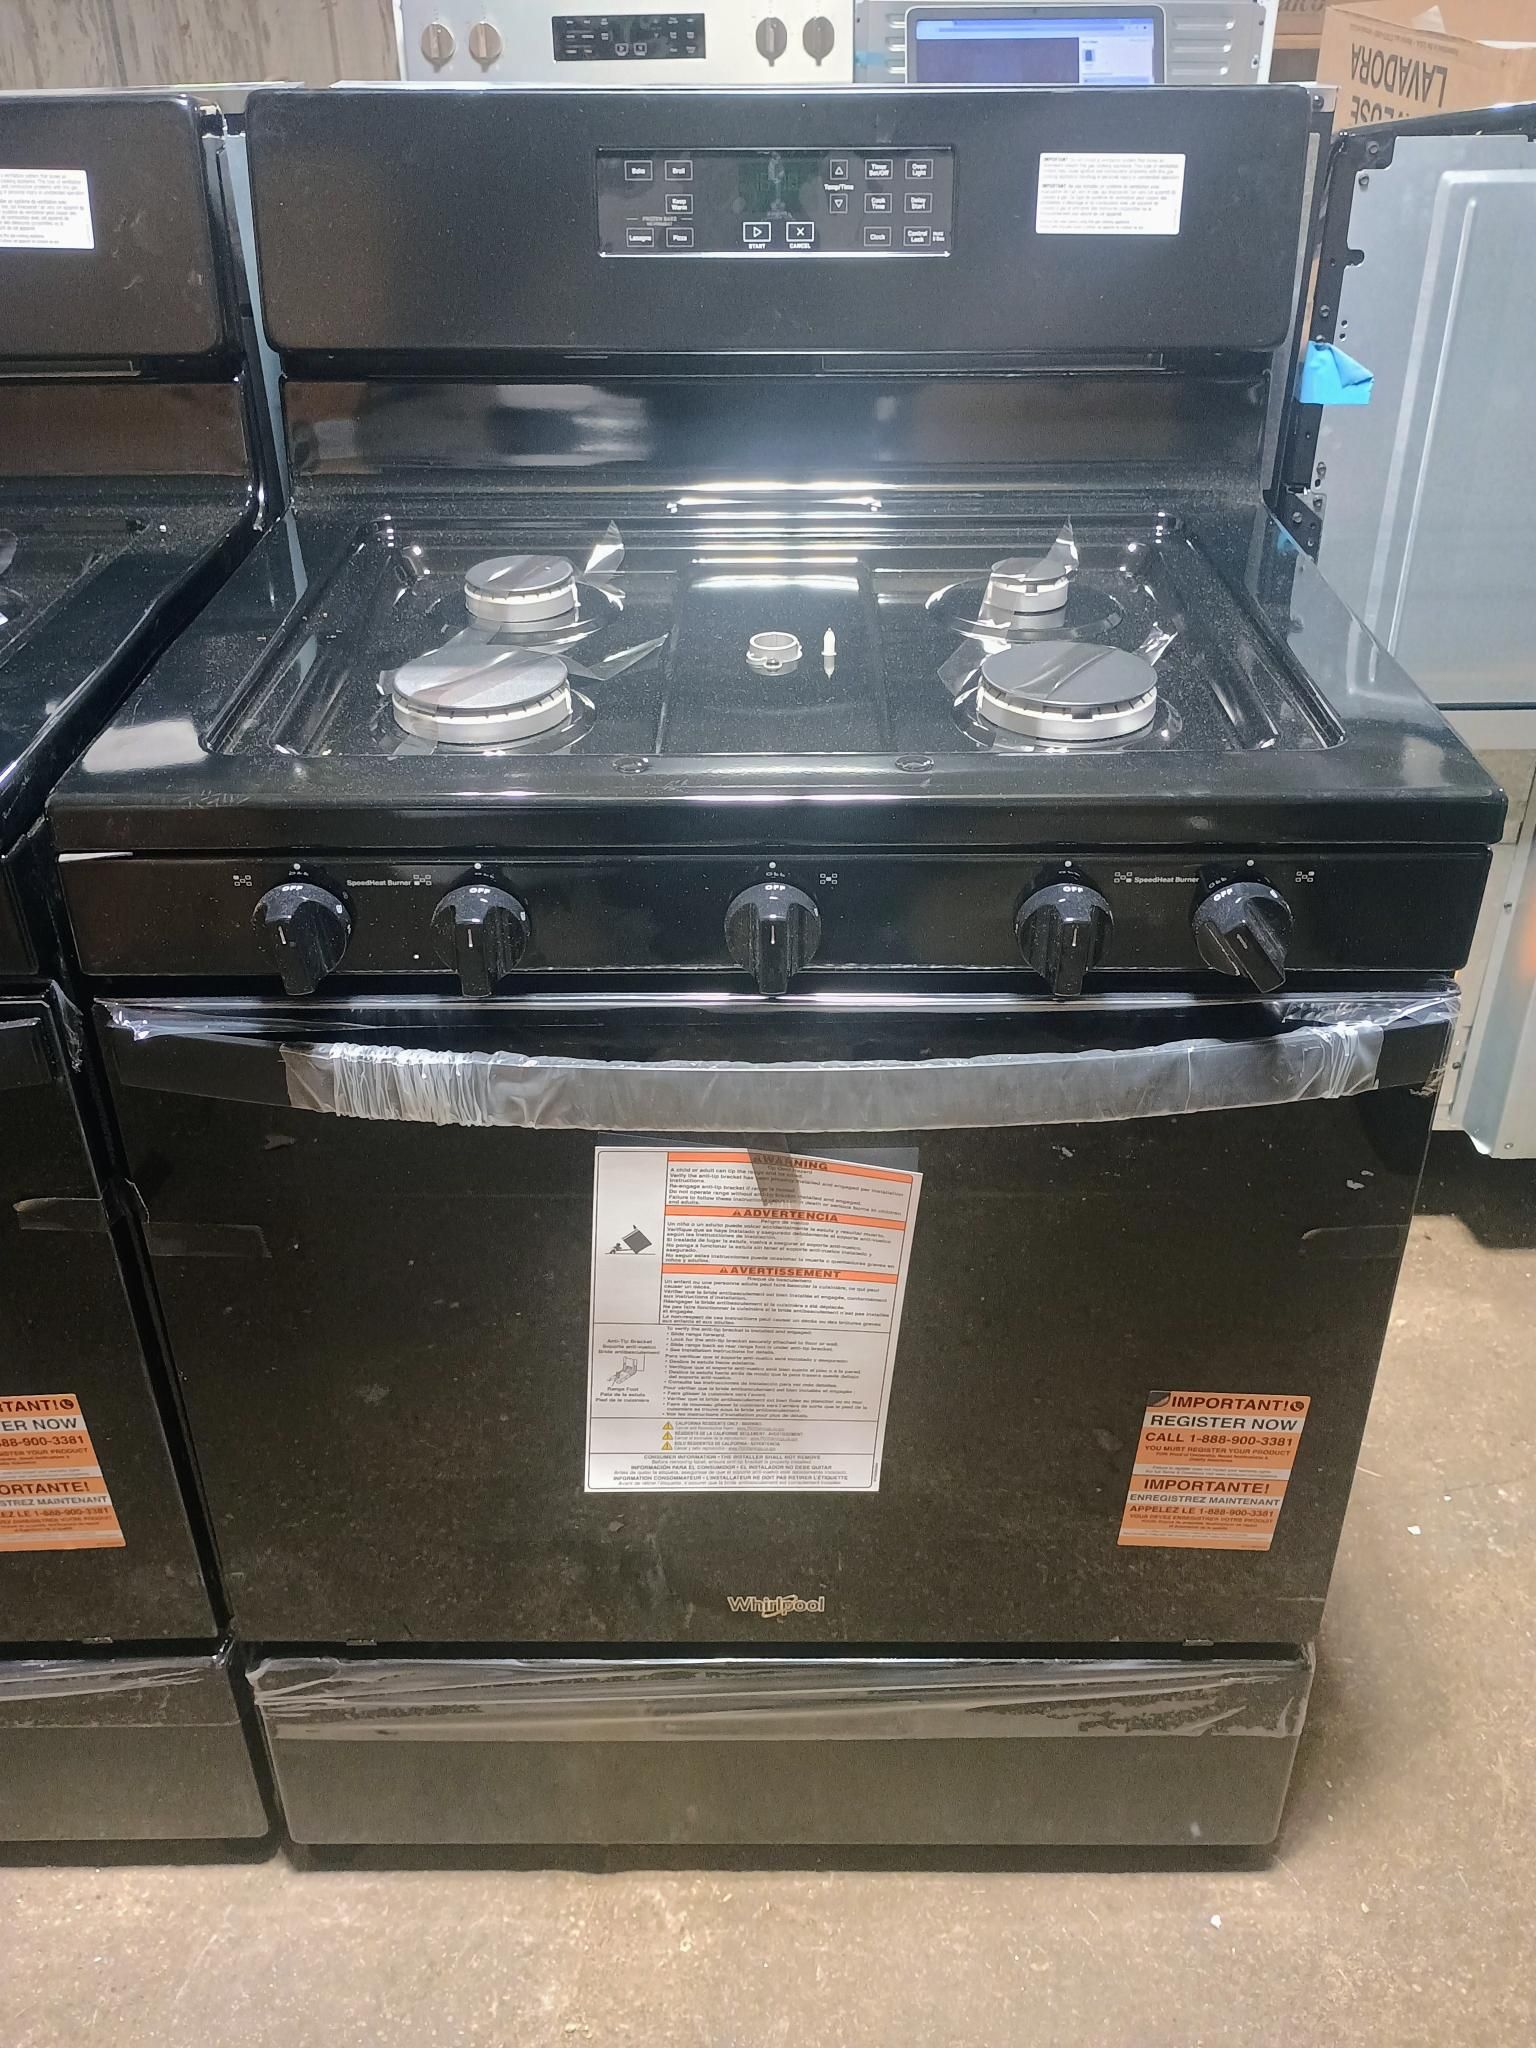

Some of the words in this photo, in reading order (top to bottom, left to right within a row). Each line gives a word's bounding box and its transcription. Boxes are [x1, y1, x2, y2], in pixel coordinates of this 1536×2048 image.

[1352, 43, 1448, 108] LAVADORA
[346, 879, 386, 887] SpeedHeat
[1134, 876, 1174, 884] SpeedHeat
[1213, 888, 1234, 902] OFF
[761, 1155, 829, 1172] WARNING
[744, 1209, 838, 1222] ADVERTENCIA
[730, 1266, 840, 1278] AVERTISSEMENT
[1172, 1396, 1288, 1412] IMPORTANT!
[33, 1418, 77, 1430] NOW
[1150, 1415, 1246, 1429] REGISTER
[1251, 1419, 1298, 1431] NOW
[0, 1436, 84, 1448] 88-900-3381
[1145, 1432, 1185, 1442] CALL
[1190, 1434, 1293, 1446] 1-888-900-3381
[1144, 1478, 1270, 1494] IMPORTANTE!
[37, 1496, 107, 1504] MAINTENANT
[1130, 1494, 1206, 1503] ENREGISTREZ
[1209, 1496, 1280, 1506] MAINTENANT
[1130, 1505, 1179, 1513] APPELEZ
[727, 1594, 825, 1618] Whirlpool
